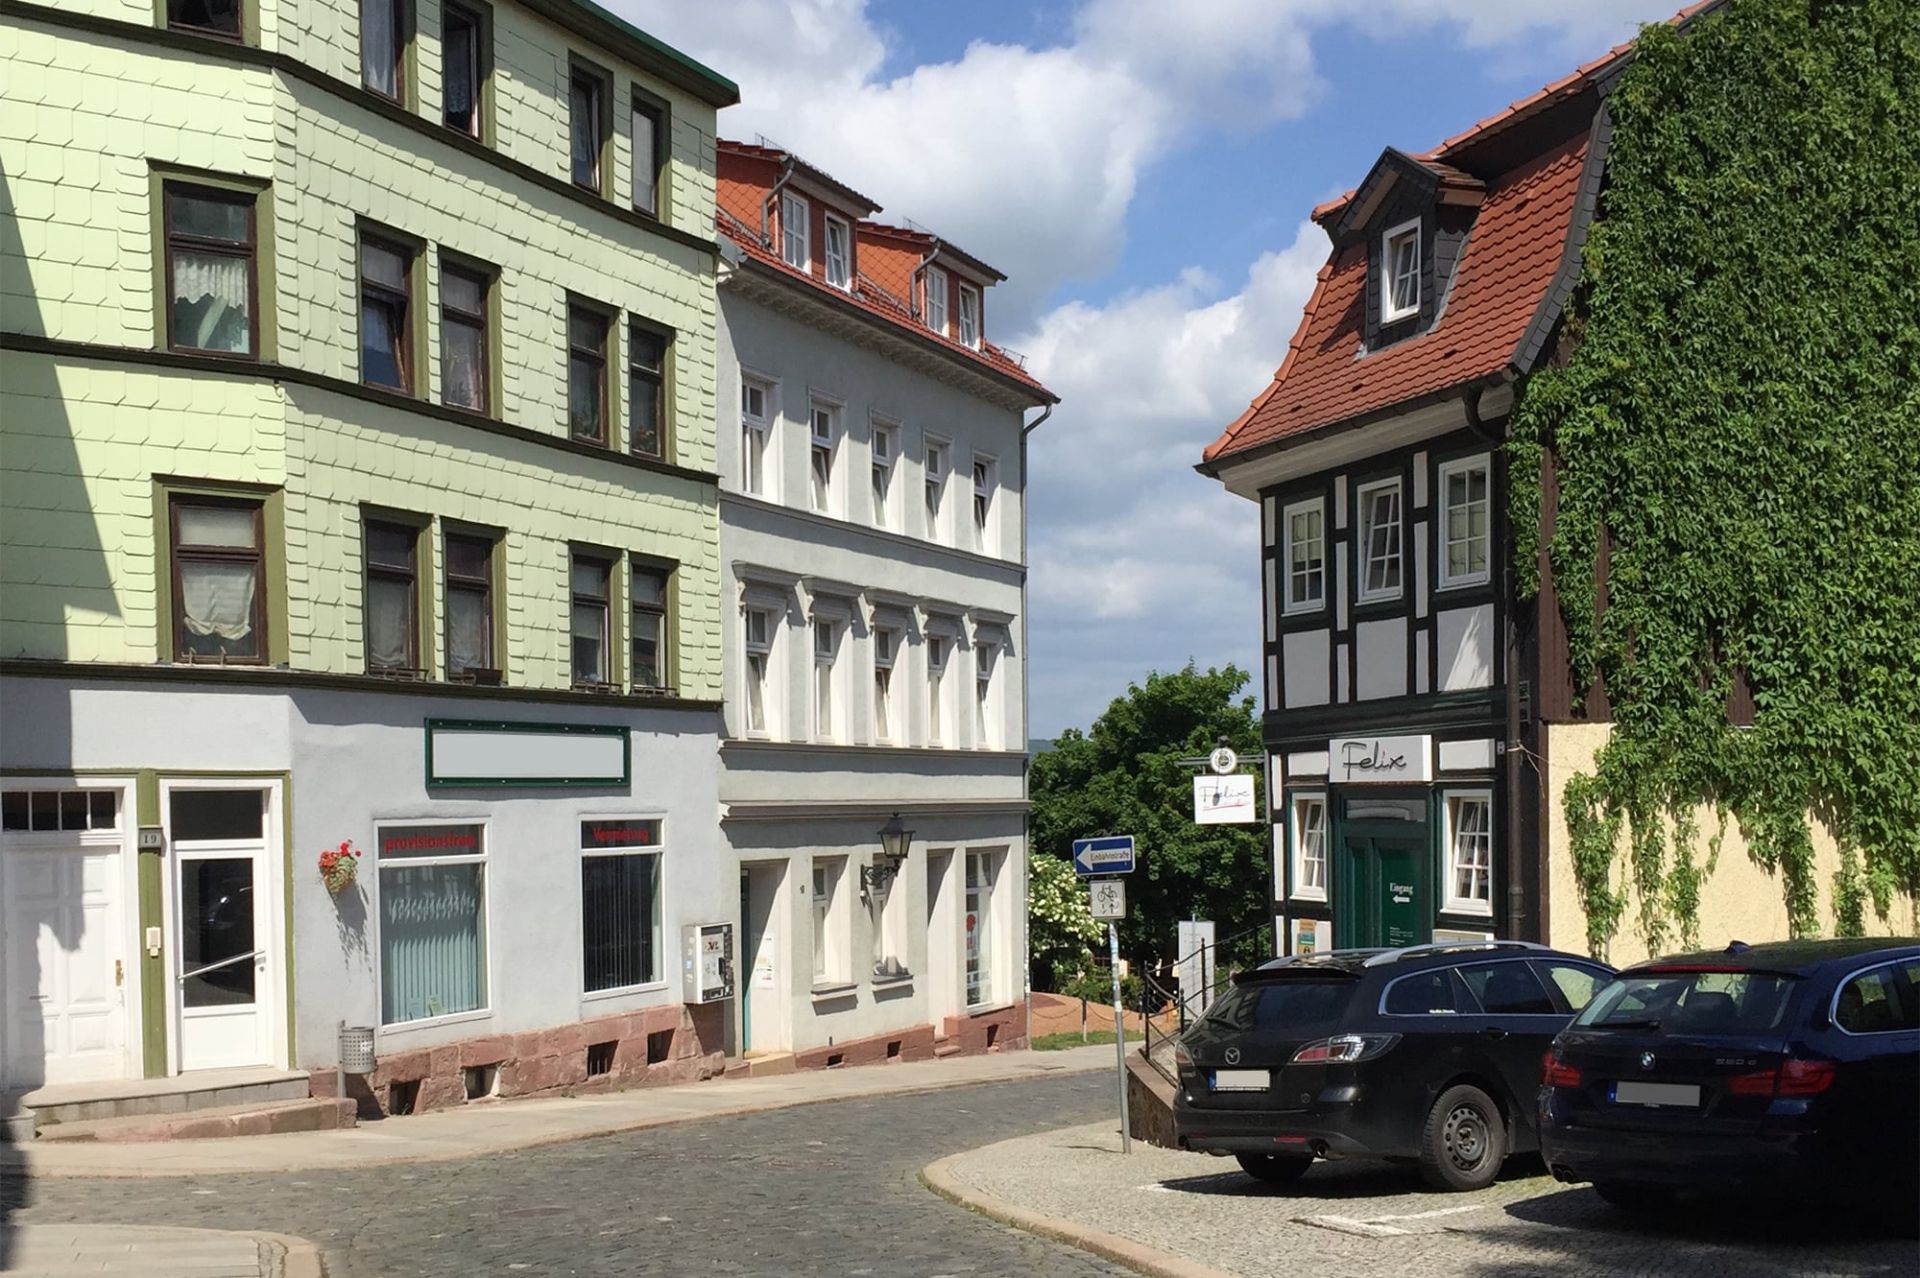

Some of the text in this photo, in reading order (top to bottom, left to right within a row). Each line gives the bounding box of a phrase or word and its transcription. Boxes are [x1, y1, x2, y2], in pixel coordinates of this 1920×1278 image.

[1341, 741, 1407, 780] Felix
[1199, 786, 1250, 803] Flix
[144, 834, 157, 844] 19
[1390, 883, 1413, 895] Eingang
